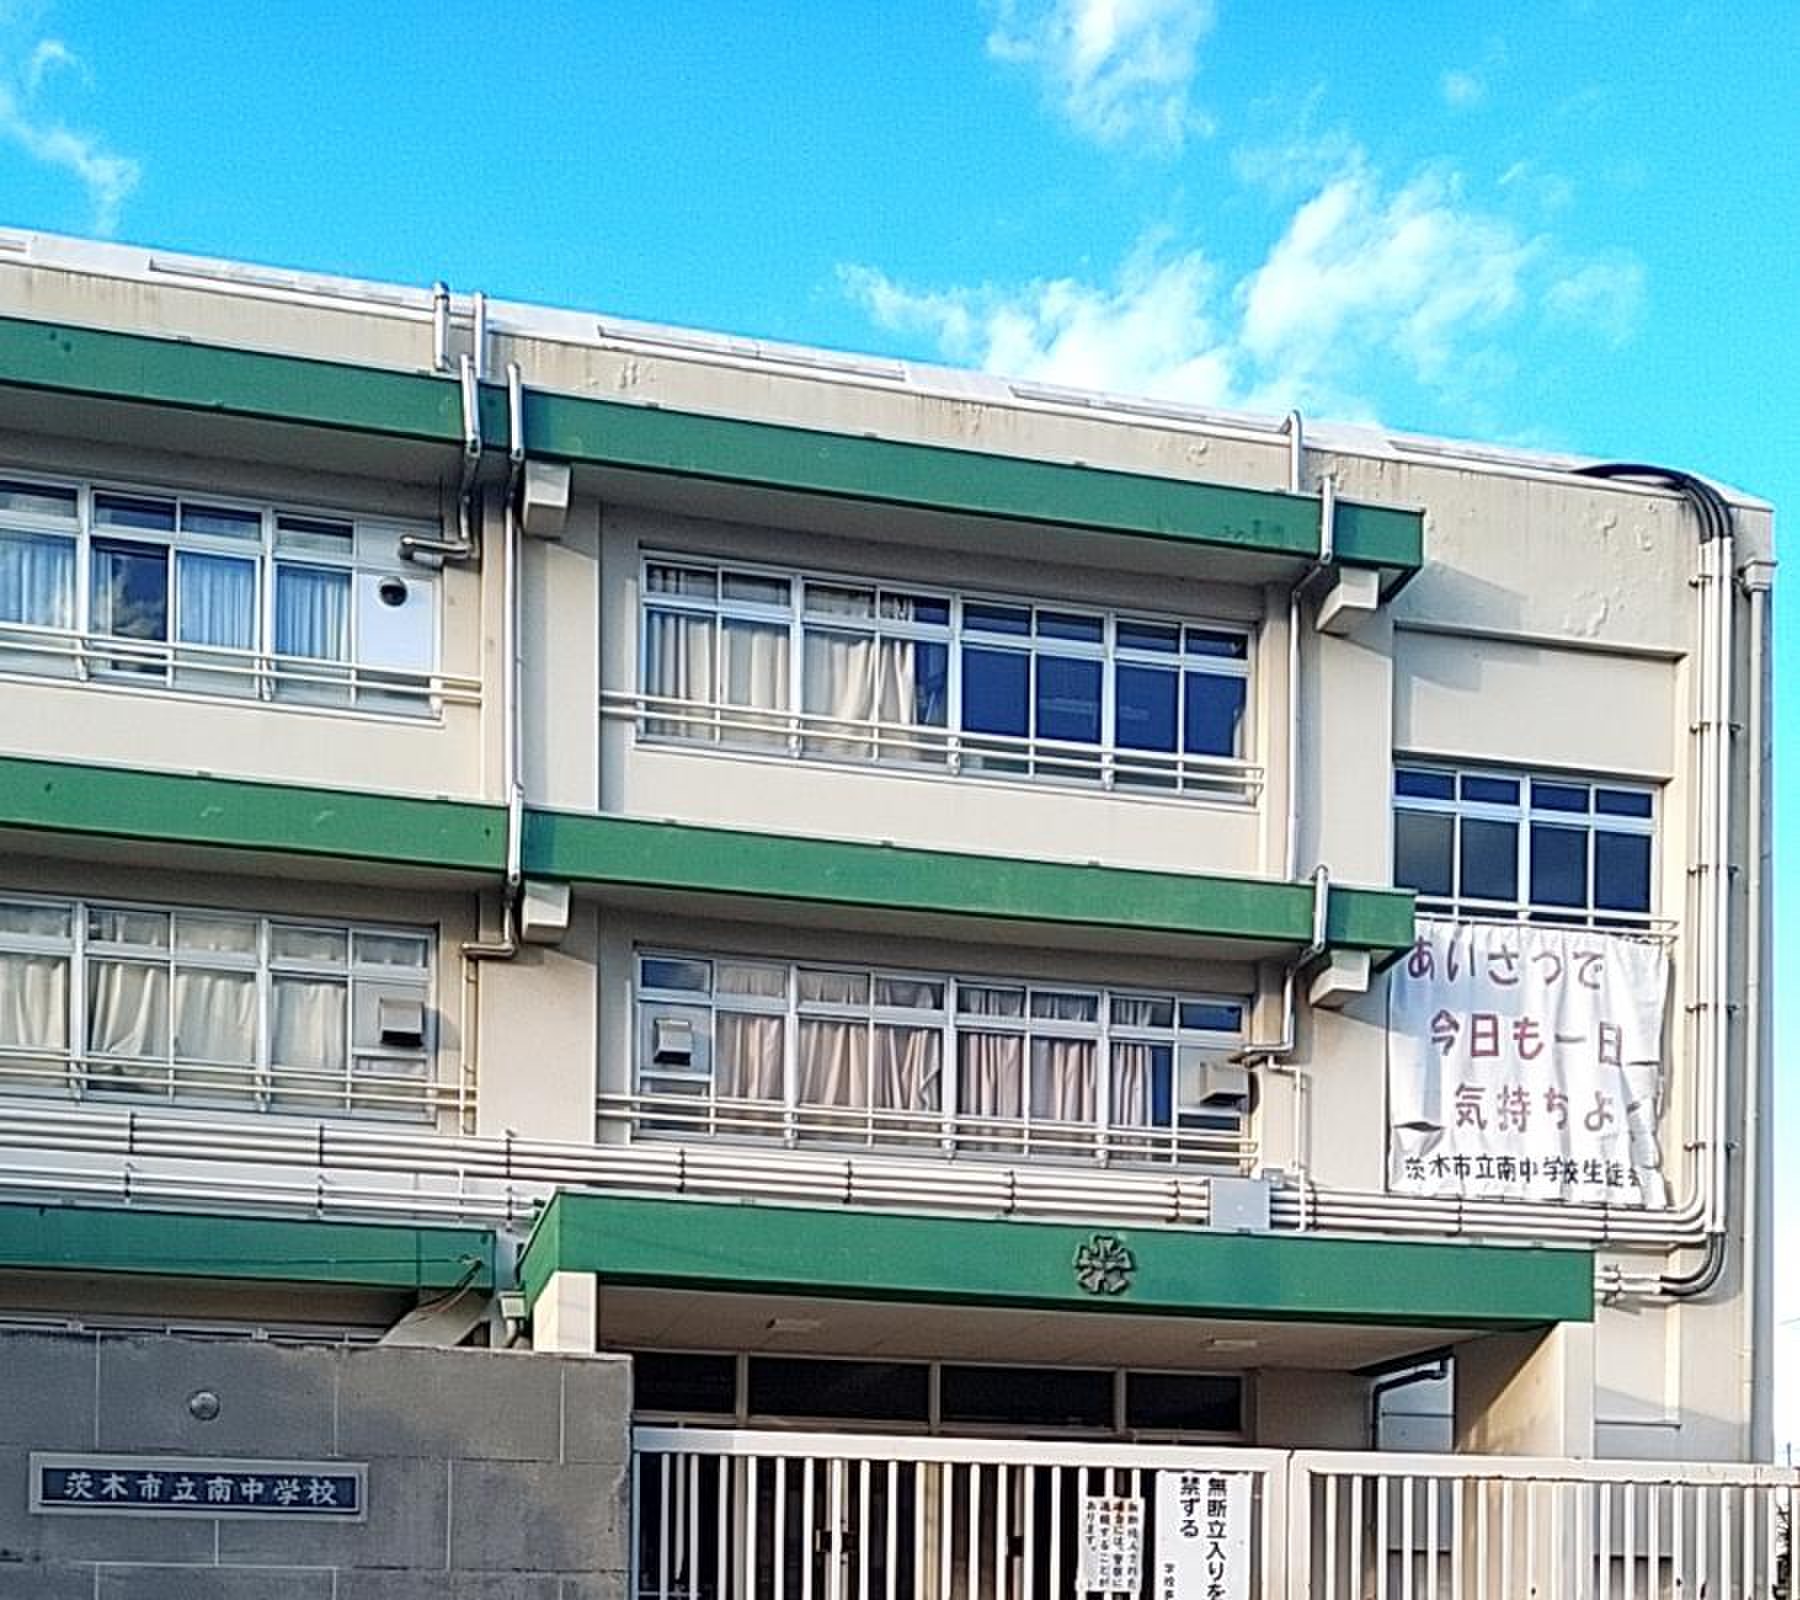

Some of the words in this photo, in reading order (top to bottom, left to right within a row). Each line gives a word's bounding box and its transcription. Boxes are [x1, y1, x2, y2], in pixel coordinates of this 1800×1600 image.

[1407, 935, 1604, 990] あいさつで
[1430, 1009, 1624, 1066] 今日も一日
[64, 1471, 337, 1505] 茨木市立南中学校
[1179, 1475, 1200, 1538] 禁ずる
